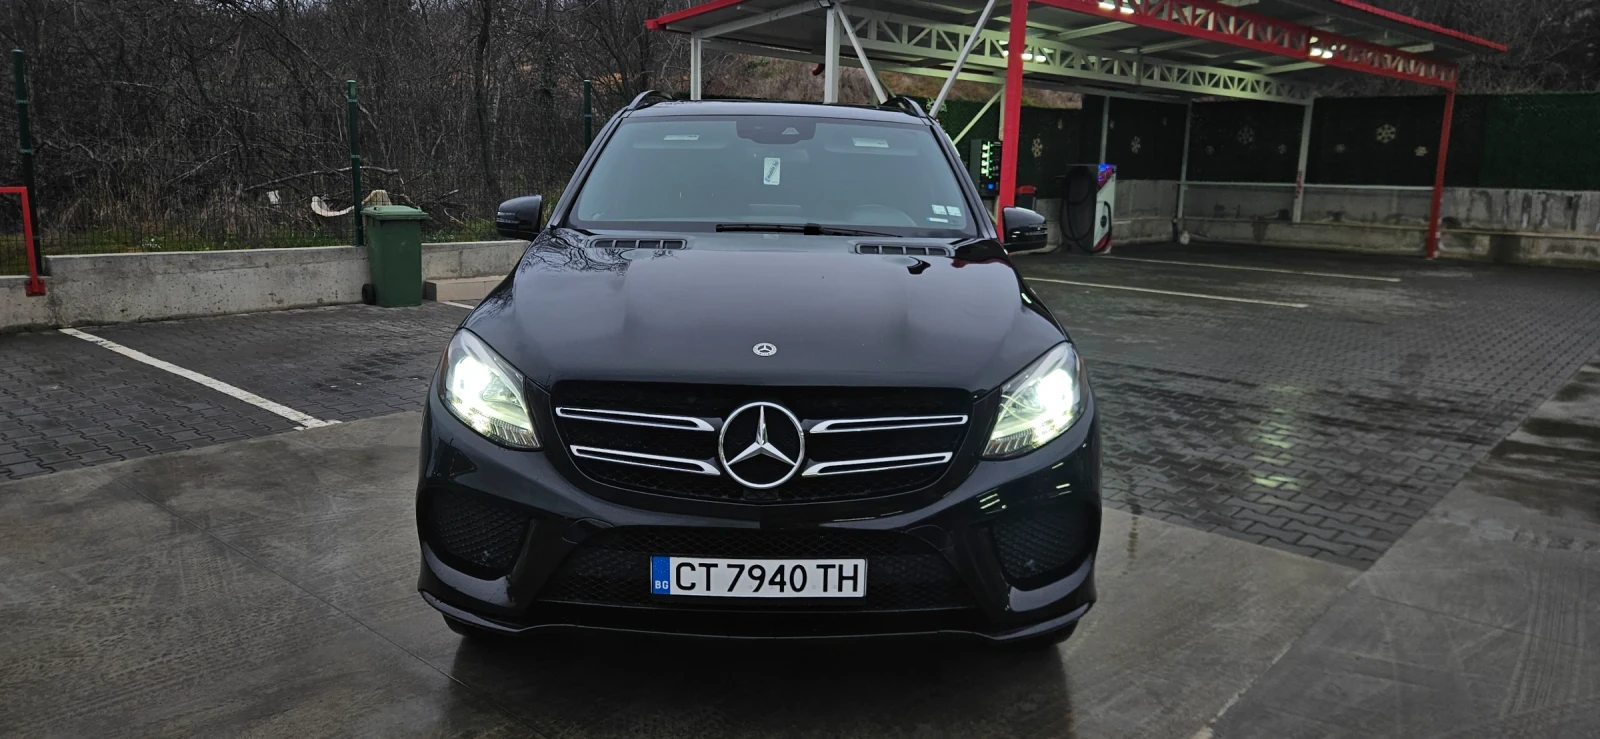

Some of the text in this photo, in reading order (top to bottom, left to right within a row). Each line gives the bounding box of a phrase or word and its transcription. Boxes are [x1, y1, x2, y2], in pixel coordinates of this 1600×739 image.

[654, 580, 669, 589] BG
[675, 562, 859, 593] CT 7940 TH
